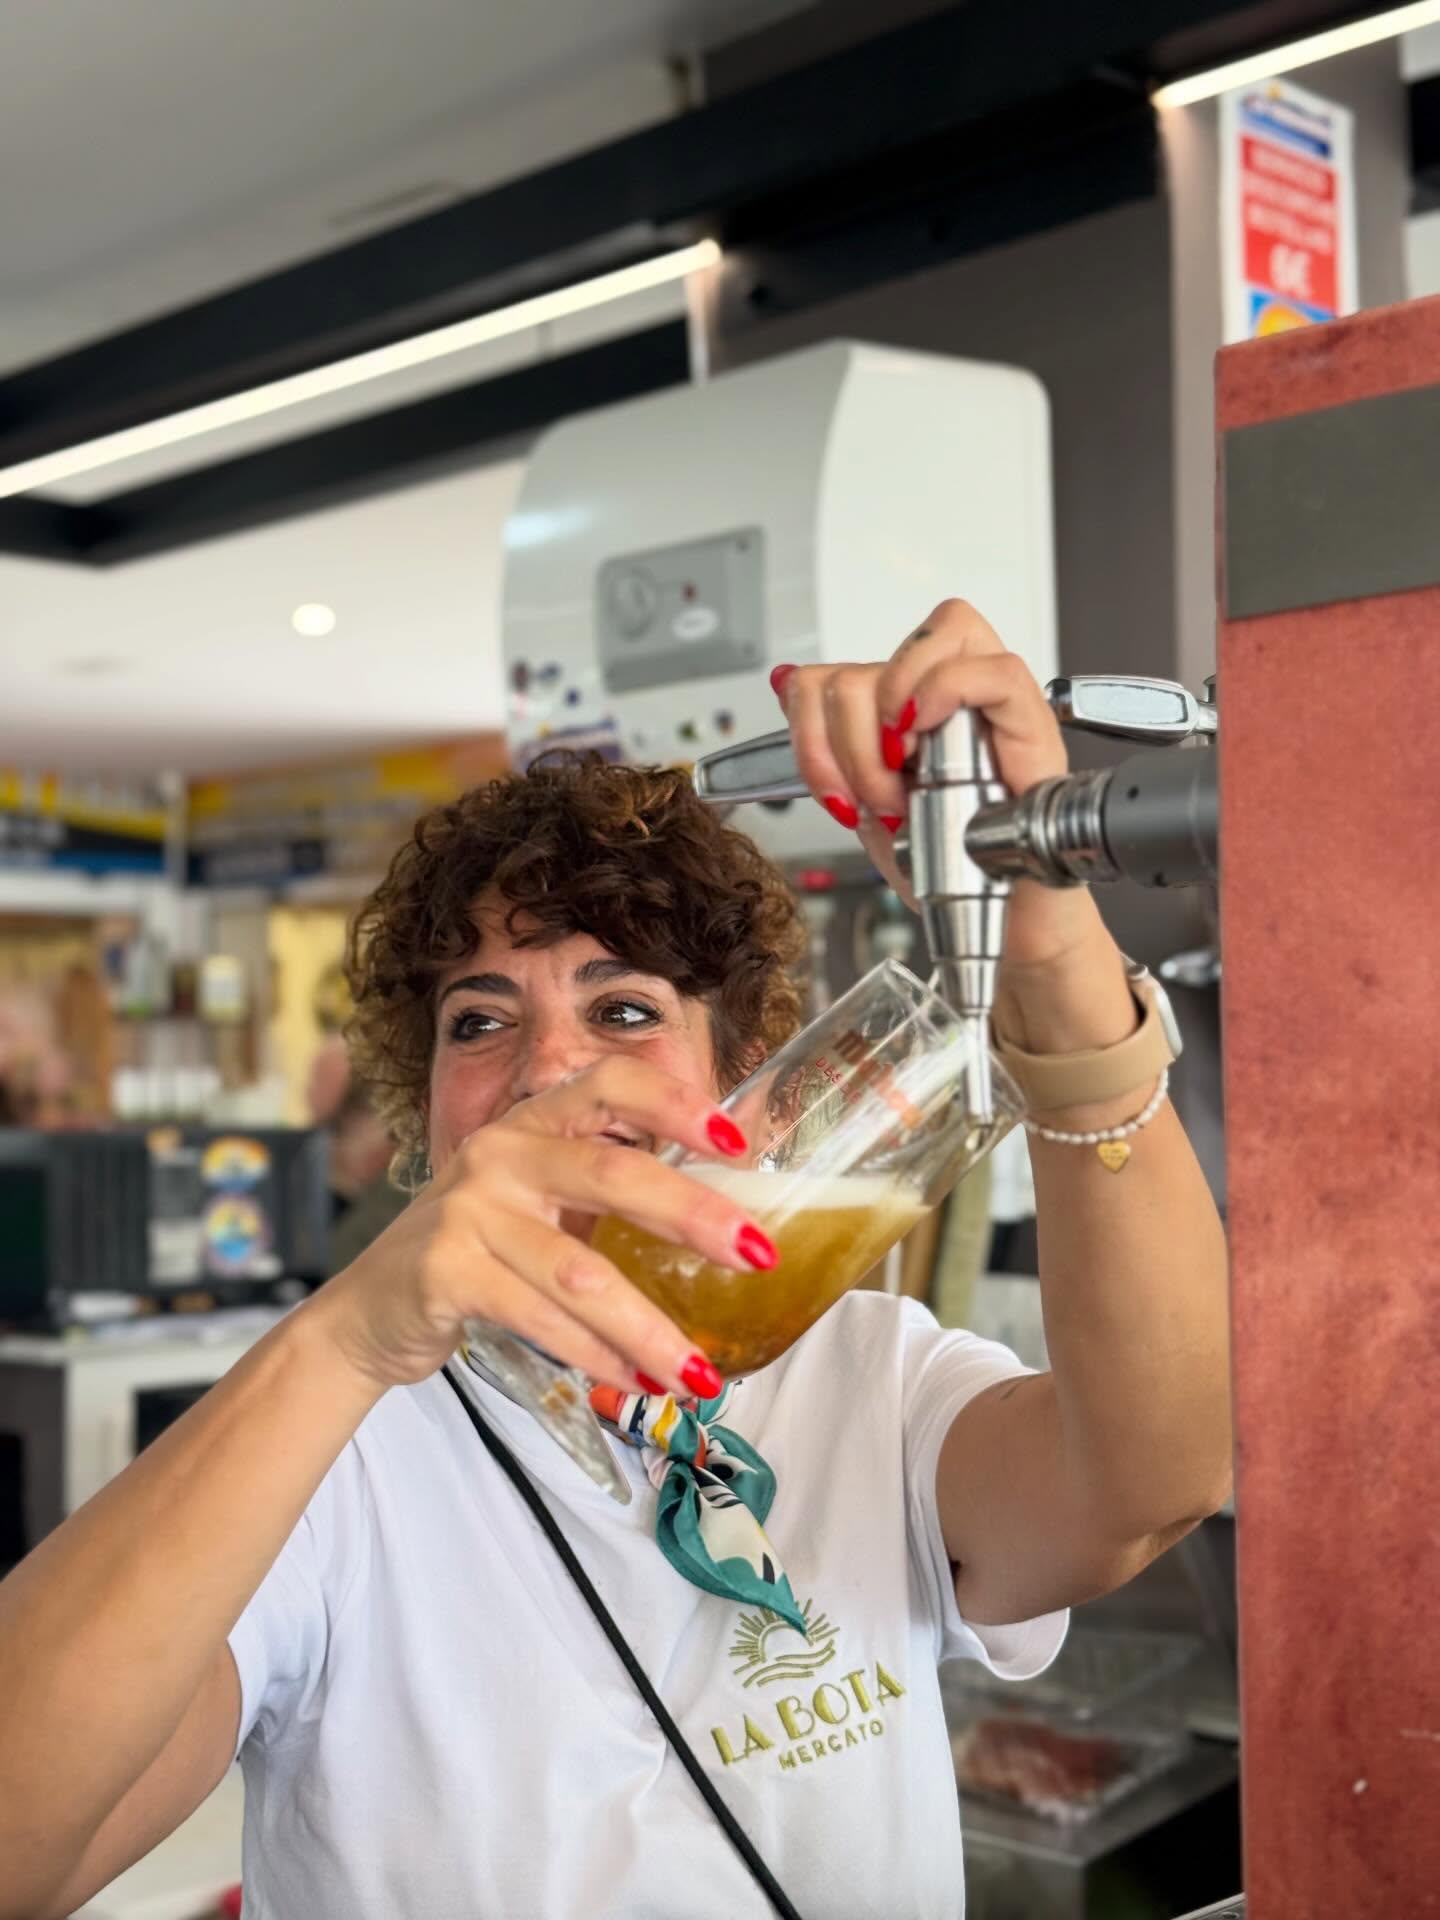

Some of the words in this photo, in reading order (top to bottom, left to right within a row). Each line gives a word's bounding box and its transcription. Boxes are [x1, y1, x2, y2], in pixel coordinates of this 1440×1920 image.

[711, 1714, 775, 1766] LA
[775, 1661, 906, 1740] BOTA
[778, 1720, 884, 1770] MERCATO
